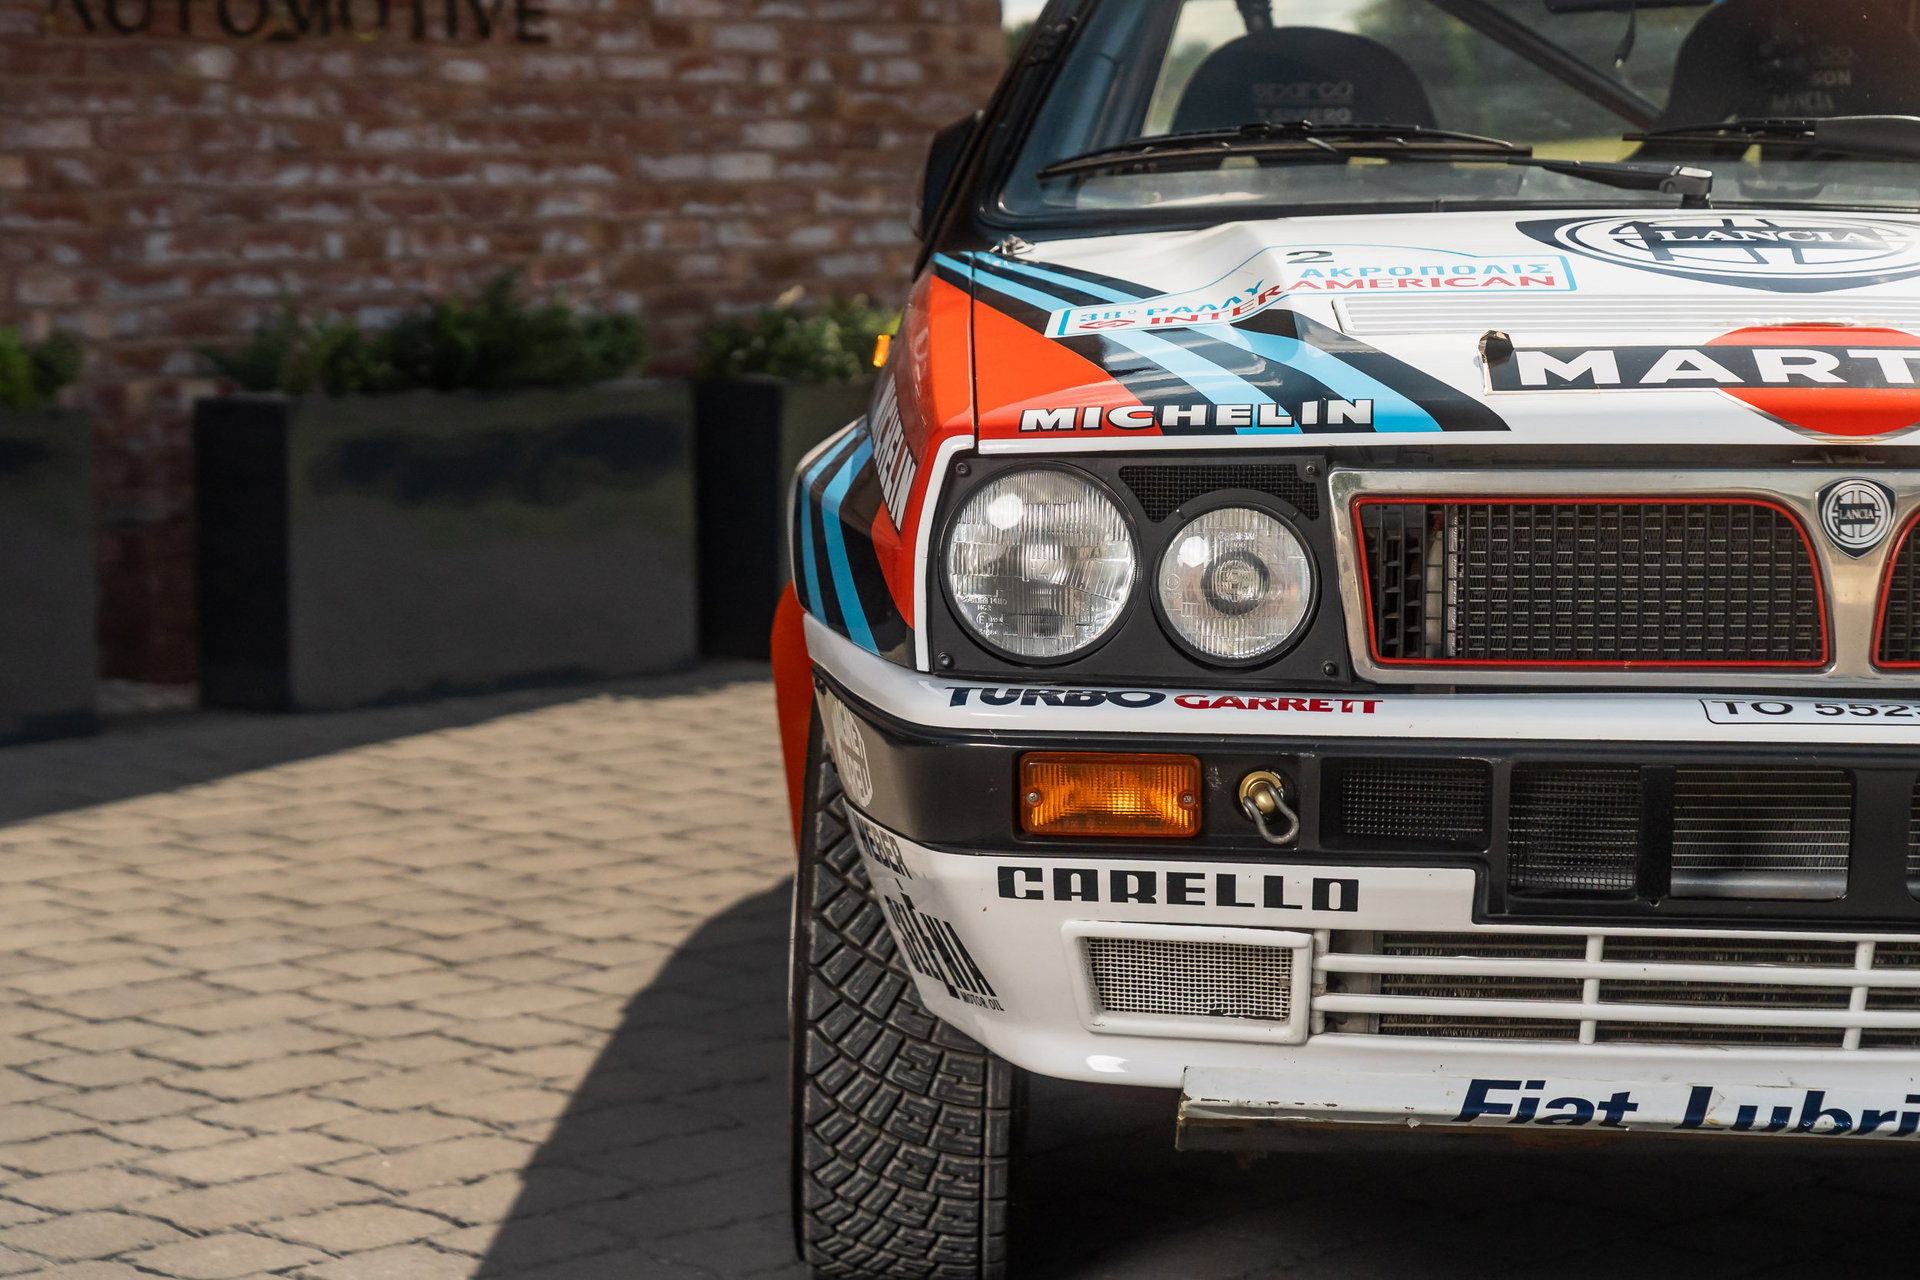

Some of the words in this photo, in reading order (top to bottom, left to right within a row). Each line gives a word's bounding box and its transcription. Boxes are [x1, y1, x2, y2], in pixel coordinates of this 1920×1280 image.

[1655, 229, 1868, 242] LANCIA
[1286, 250, 1334, 264] 2
[1515, 348, 1920, 387] MART
[1018, 398, 1375, 433] MICHELIN
[1839, 508, 1875, 520] LANCIA
[945, 686, 1167, 708] TURBO
[1173, 694, 1384, 714] GARRETT
[1711, 700, 1794, 716] TO
[1814, 702, 1920, 717] 552
[854, 813, 913, 881] WEBER
[997, 865, 1360, 913] CARELLO
[960, 989, 988, 1009] MOTOR
[987, 999, 1005, 1012] OIL
[1451, 1078, 1639, 1130] Fiat
[1673, 1085, 1920, 1138] Lubri
